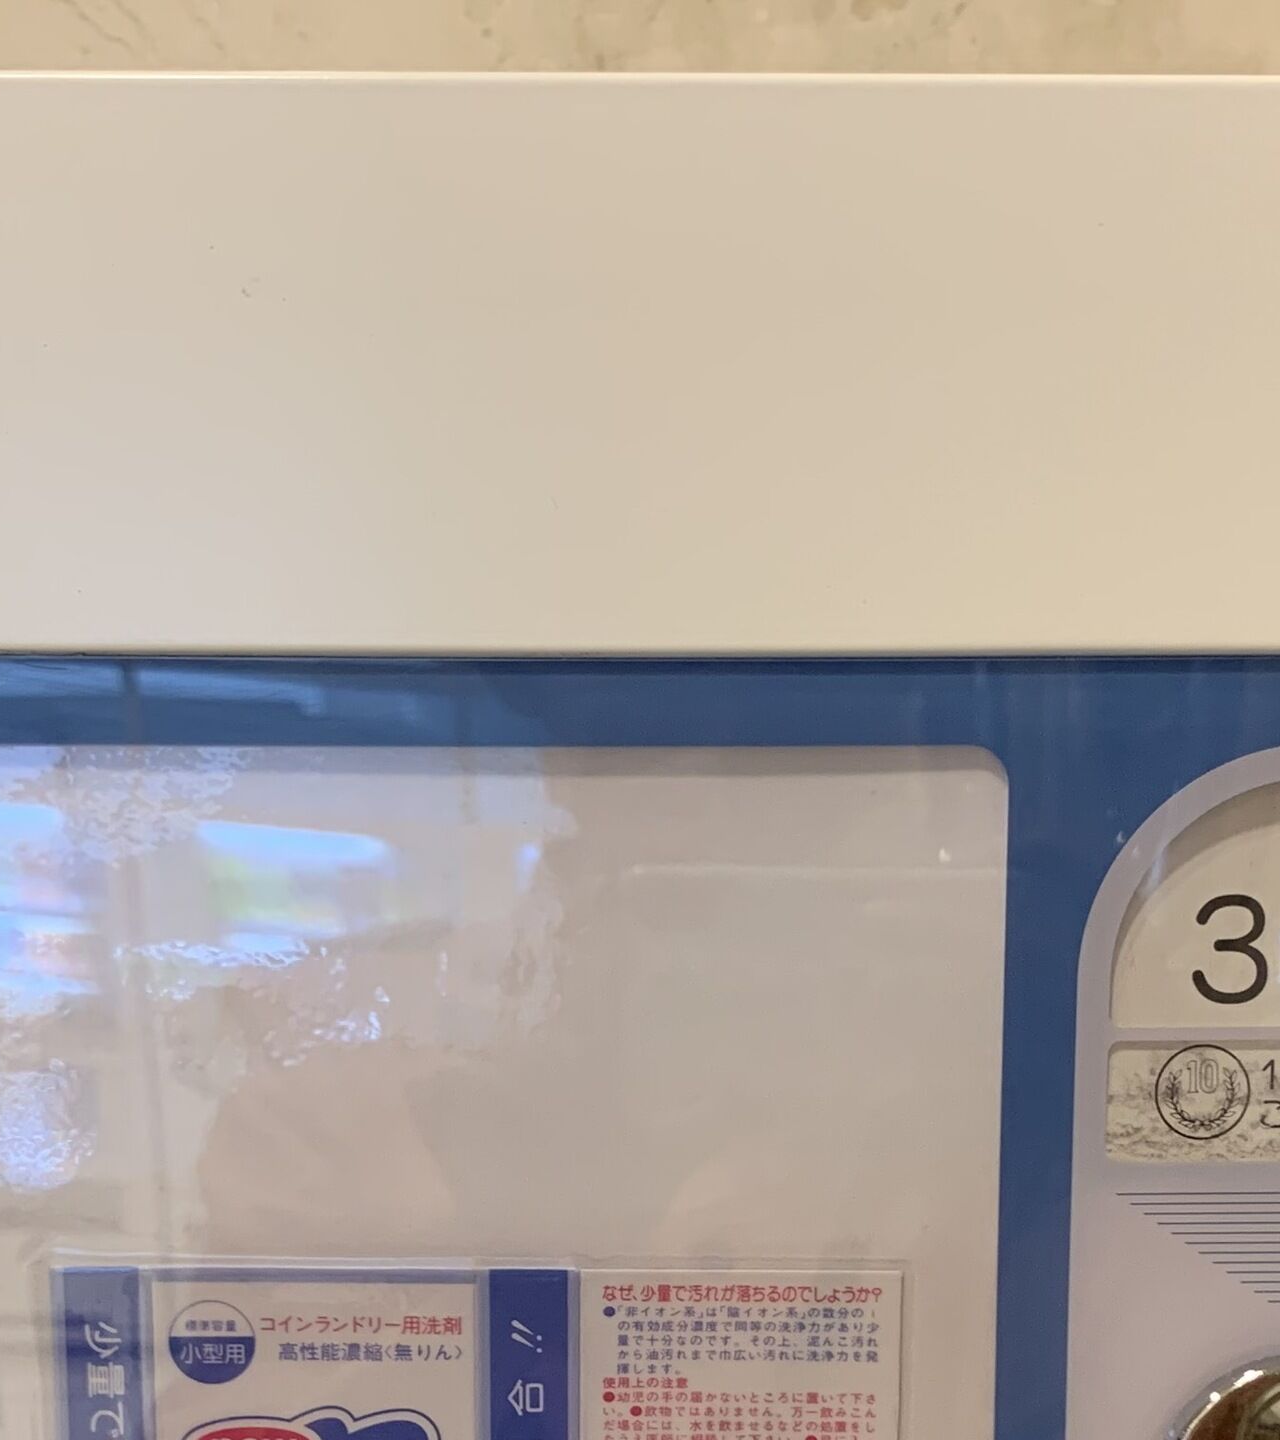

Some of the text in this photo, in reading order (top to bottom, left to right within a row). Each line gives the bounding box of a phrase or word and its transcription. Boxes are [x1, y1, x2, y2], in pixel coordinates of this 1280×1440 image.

[260, 1316, 463, 1335] コインランドリー用洗剤
[180, 1344, 246, 1365] 小型用
[602, 1377, 688, 1389] 使用上の注意
